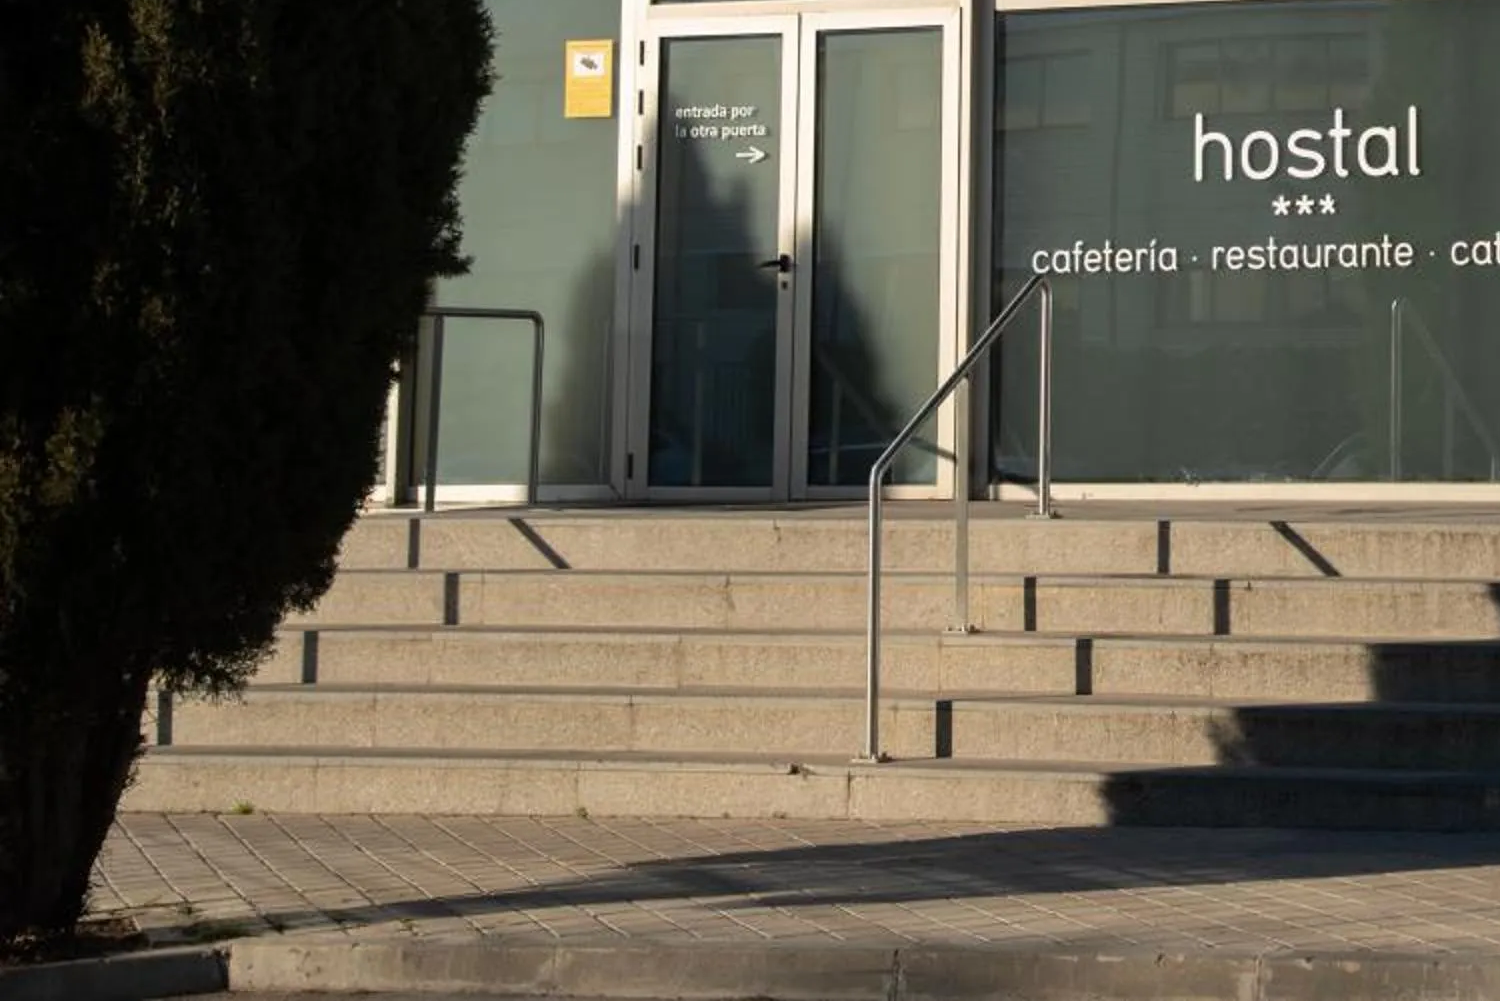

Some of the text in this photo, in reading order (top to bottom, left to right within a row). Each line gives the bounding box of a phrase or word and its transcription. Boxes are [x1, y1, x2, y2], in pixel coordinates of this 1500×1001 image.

[675, 103, 755, 121] entrada por
[675, 124, 766, 140] la otra puerta
[1194, 105, 1420, 182] hostal
[1032, 237, 1178, 274] cafetería
[1211, 235, 1414, 271] restaurante
